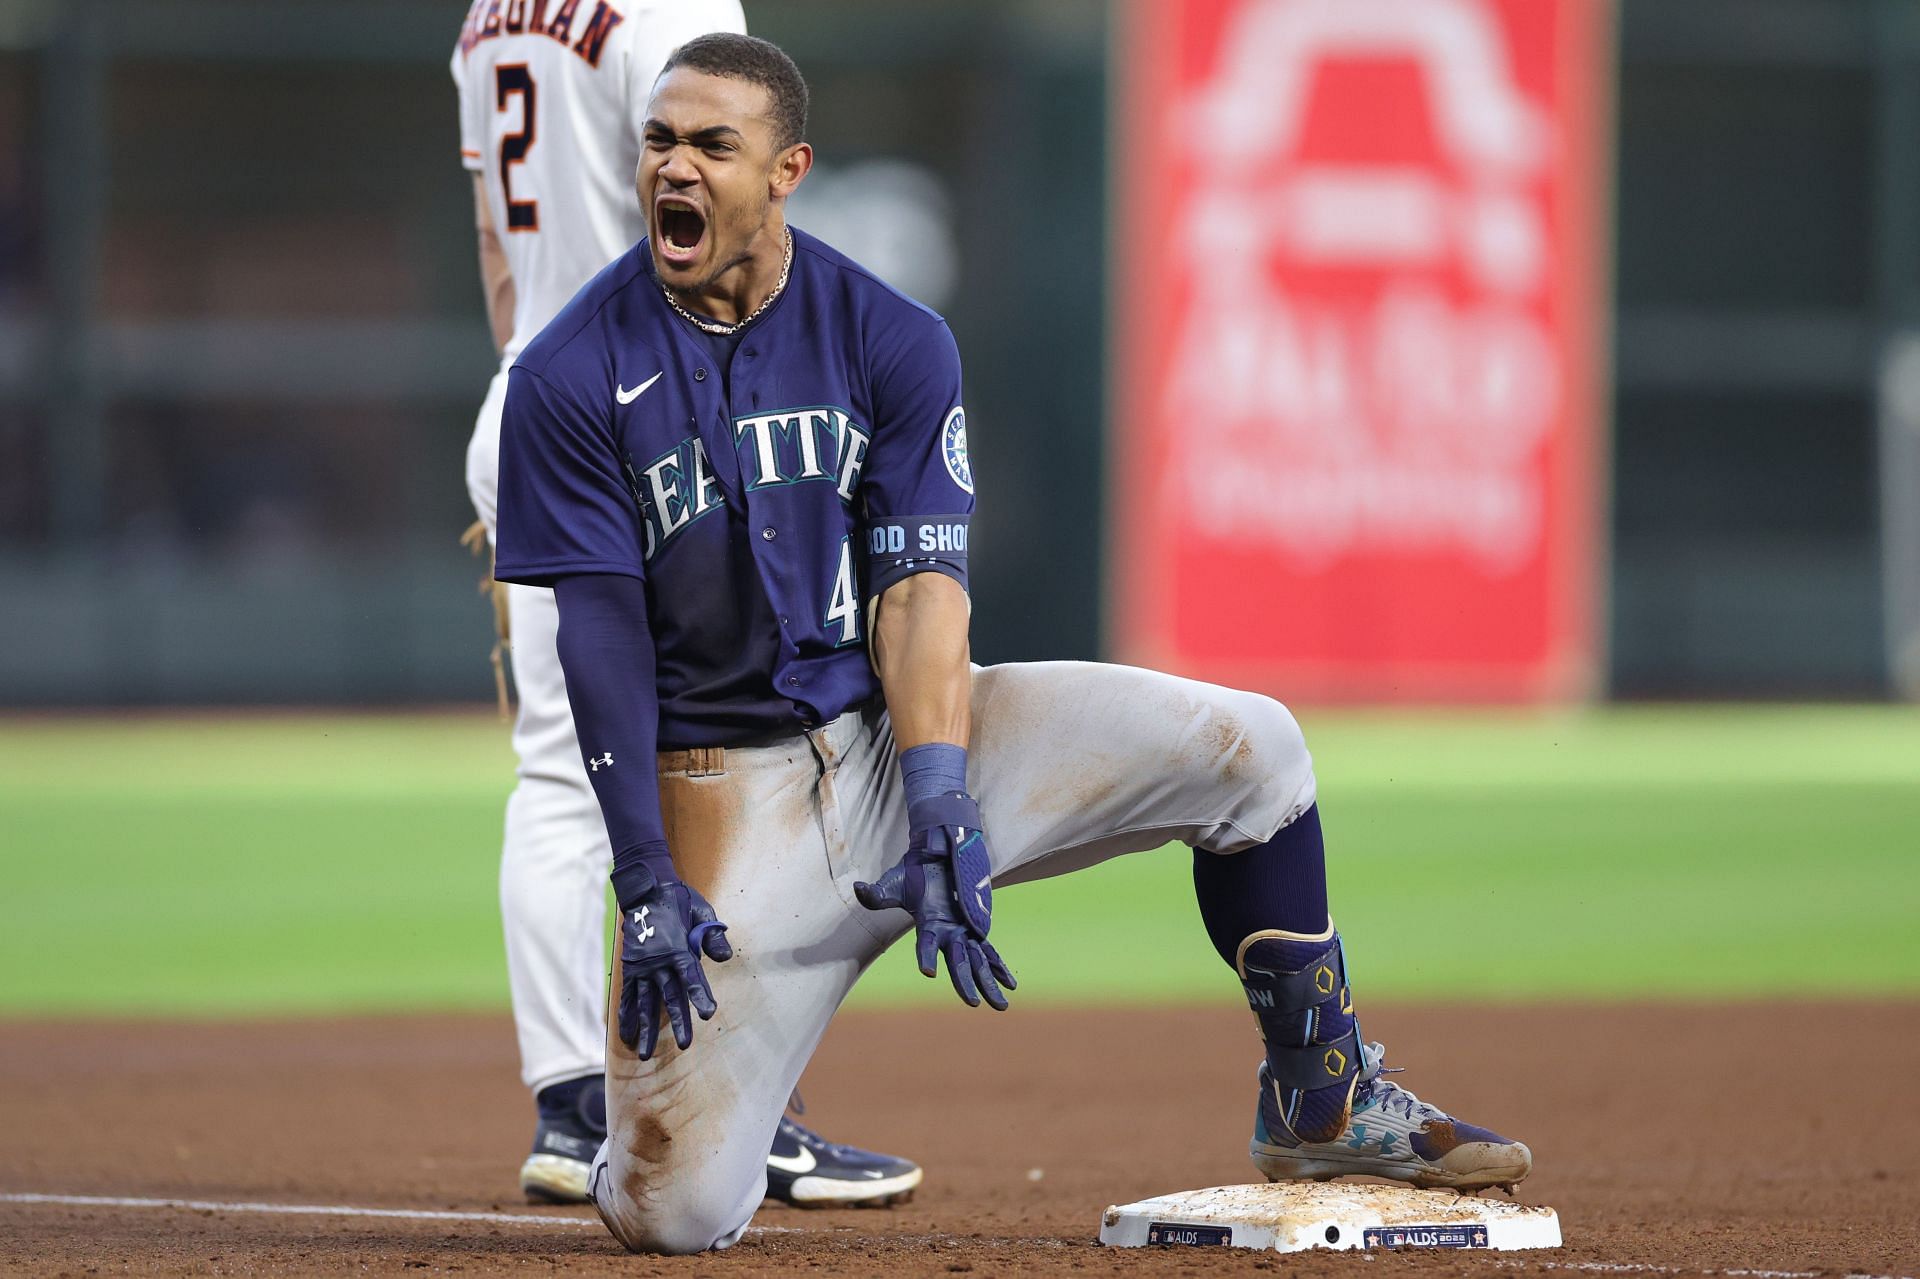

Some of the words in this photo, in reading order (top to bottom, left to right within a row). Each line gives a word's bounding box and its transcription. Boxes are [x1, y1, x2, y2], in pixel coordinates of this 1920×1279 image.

[496, 61, 538, 232] 2
[919, 524, 969, 552] SHO
[824, 536, 860, 647] 4
[1174, 1231, 1198, 1244] ALDS
[1405, 1232, 1438, 1246] ALDS
[1439, 1235, 1466, 1243] 2022
